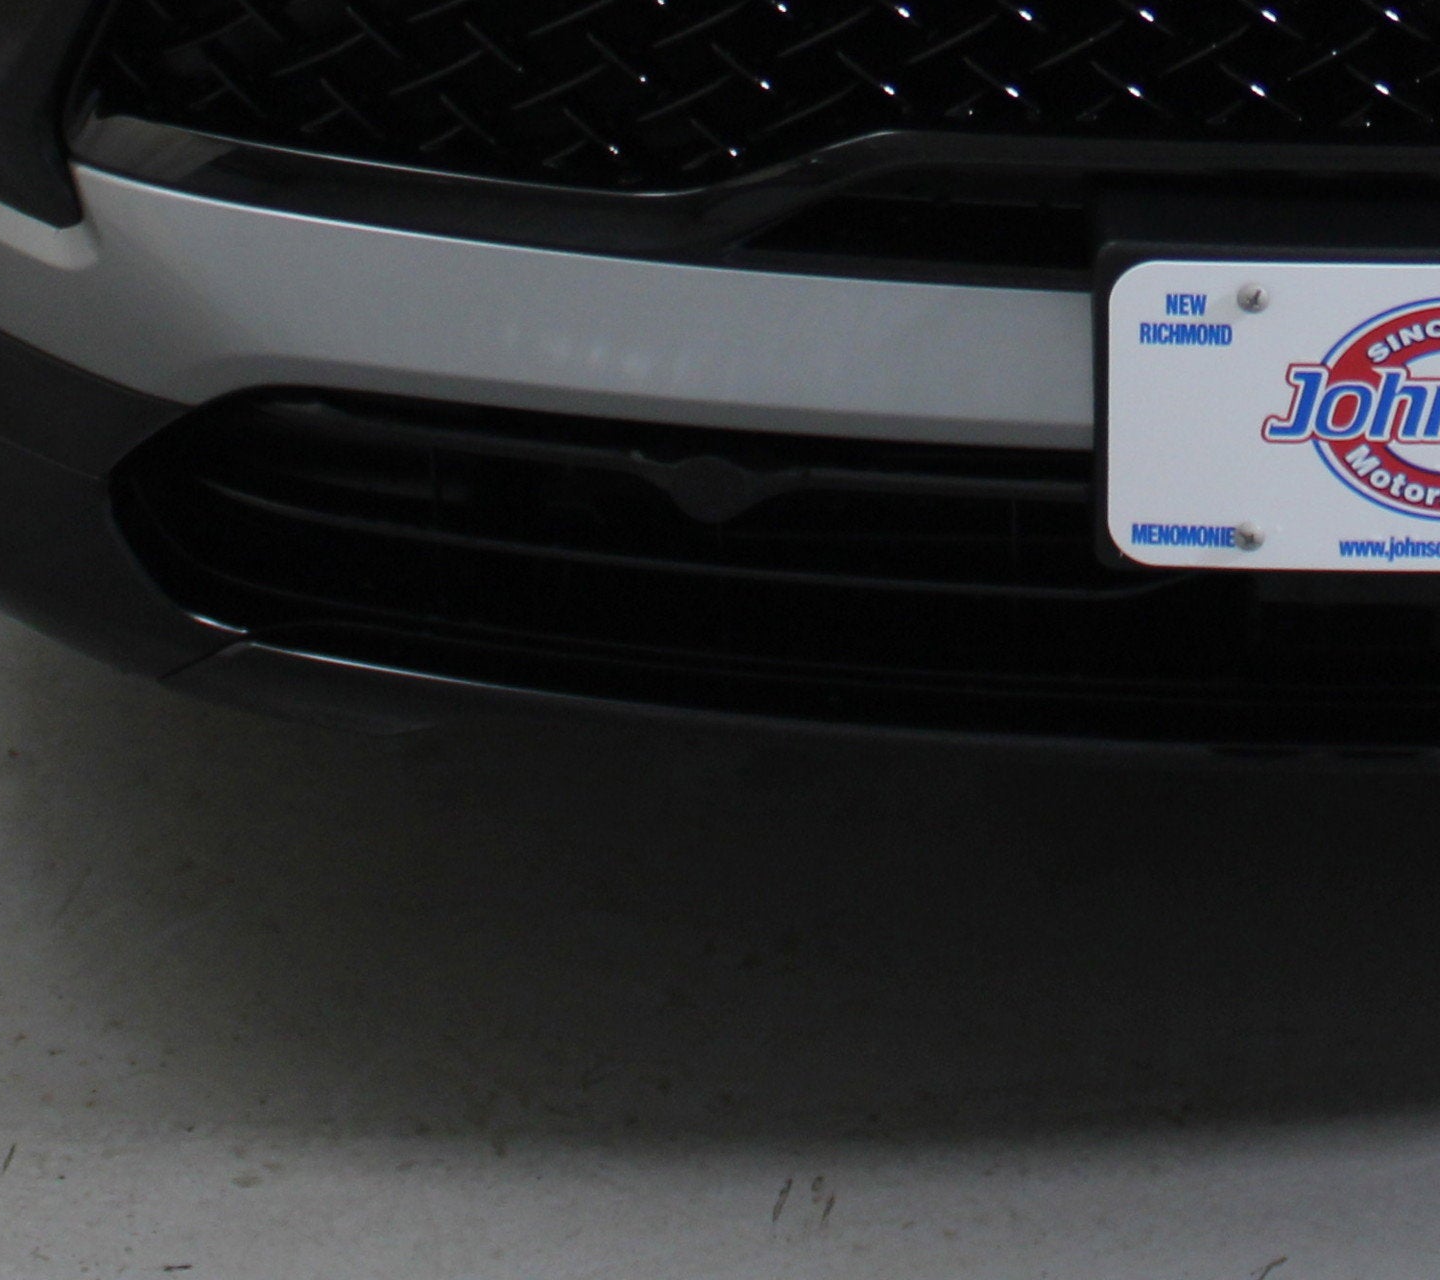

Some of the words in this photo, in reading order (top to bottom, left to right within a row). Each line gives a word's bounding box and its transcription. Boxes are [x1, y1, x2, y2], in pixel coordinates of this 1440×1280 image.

[1166, 294, 1207, 316] NEW
[1140, 322, 1233, 346] RICHMOND
[1131, 523, 1237, 548] MENOMONIE
